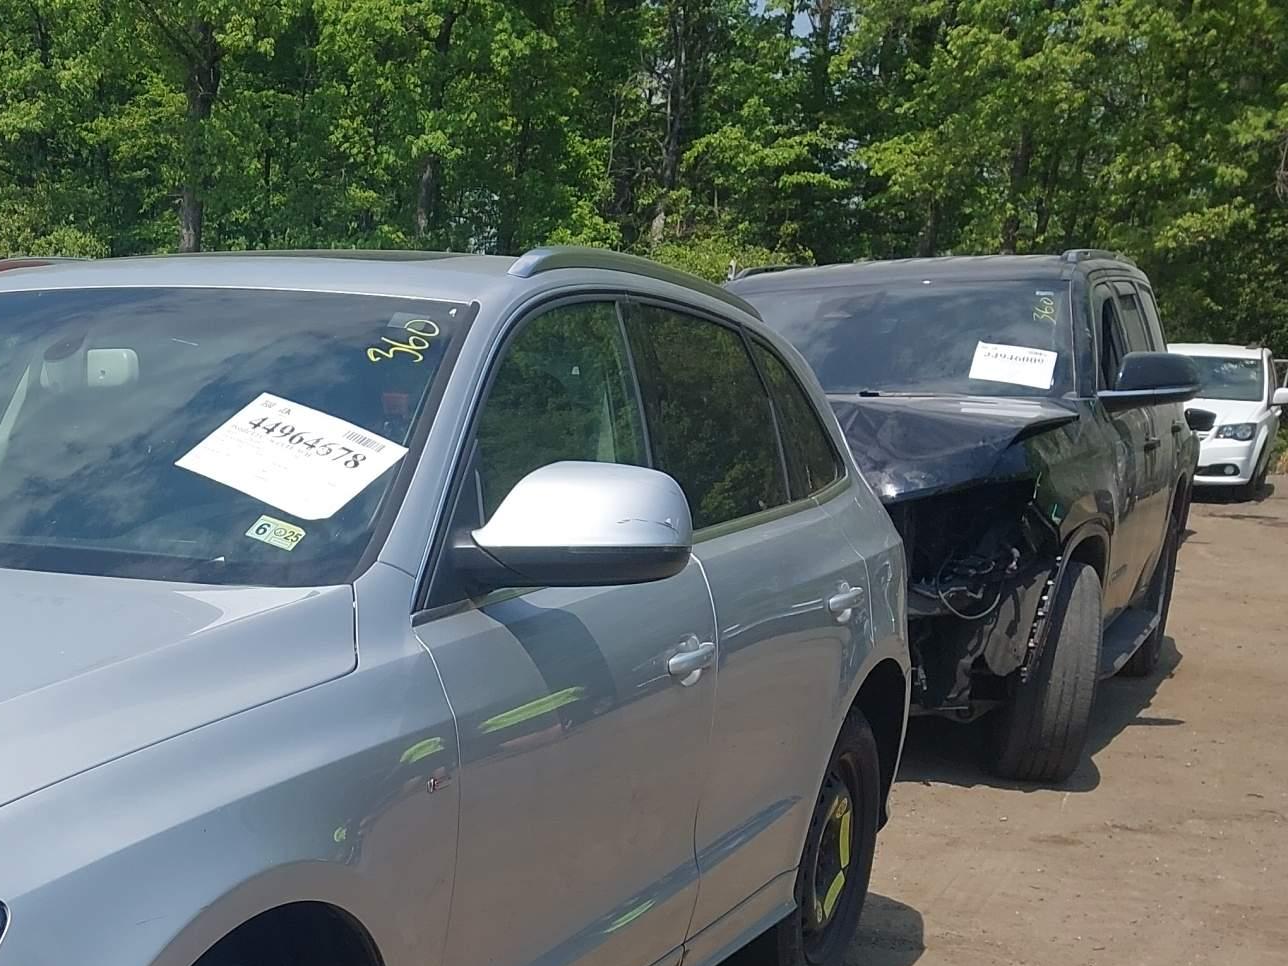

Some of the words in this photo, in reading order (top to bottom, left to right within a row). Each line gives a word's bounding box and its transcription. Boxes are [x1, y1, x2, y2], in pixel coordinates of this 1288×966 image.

[1033, 297, 1056, 325] 360
[367, 319, 440, 362] 360
[255, 523, 271, 535] 6
[283, 530, 303, 543] 25
